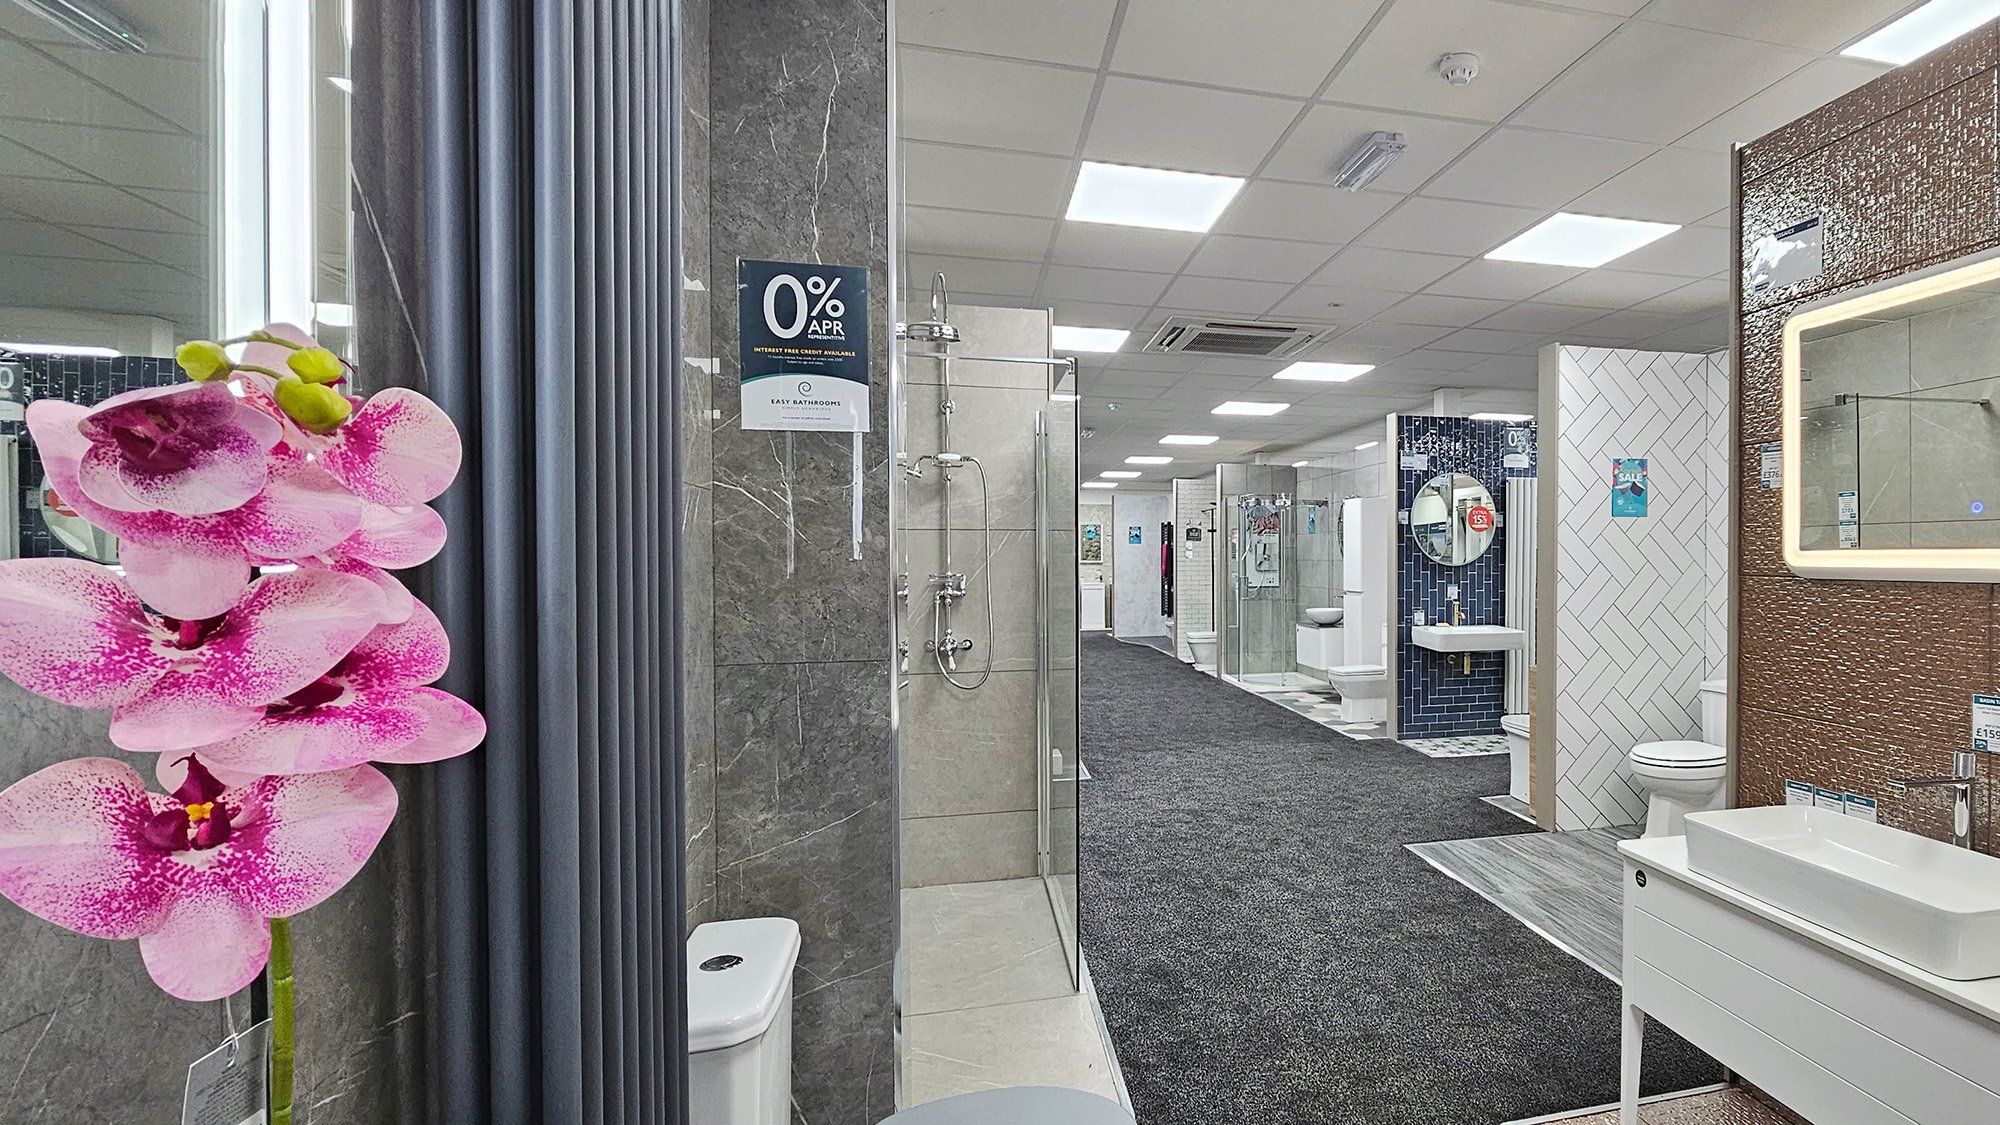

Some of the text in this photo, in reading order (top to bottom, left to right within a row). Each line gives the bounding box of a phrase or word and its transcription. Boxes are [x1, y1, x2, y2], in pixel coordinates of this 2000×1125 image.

[763, 273, 845, 339] 0%
[807, 318, 846, 335] APR
[823, 349, 856, 357] AVAILABLE
[1618, 473, 1643, 482] SALE
